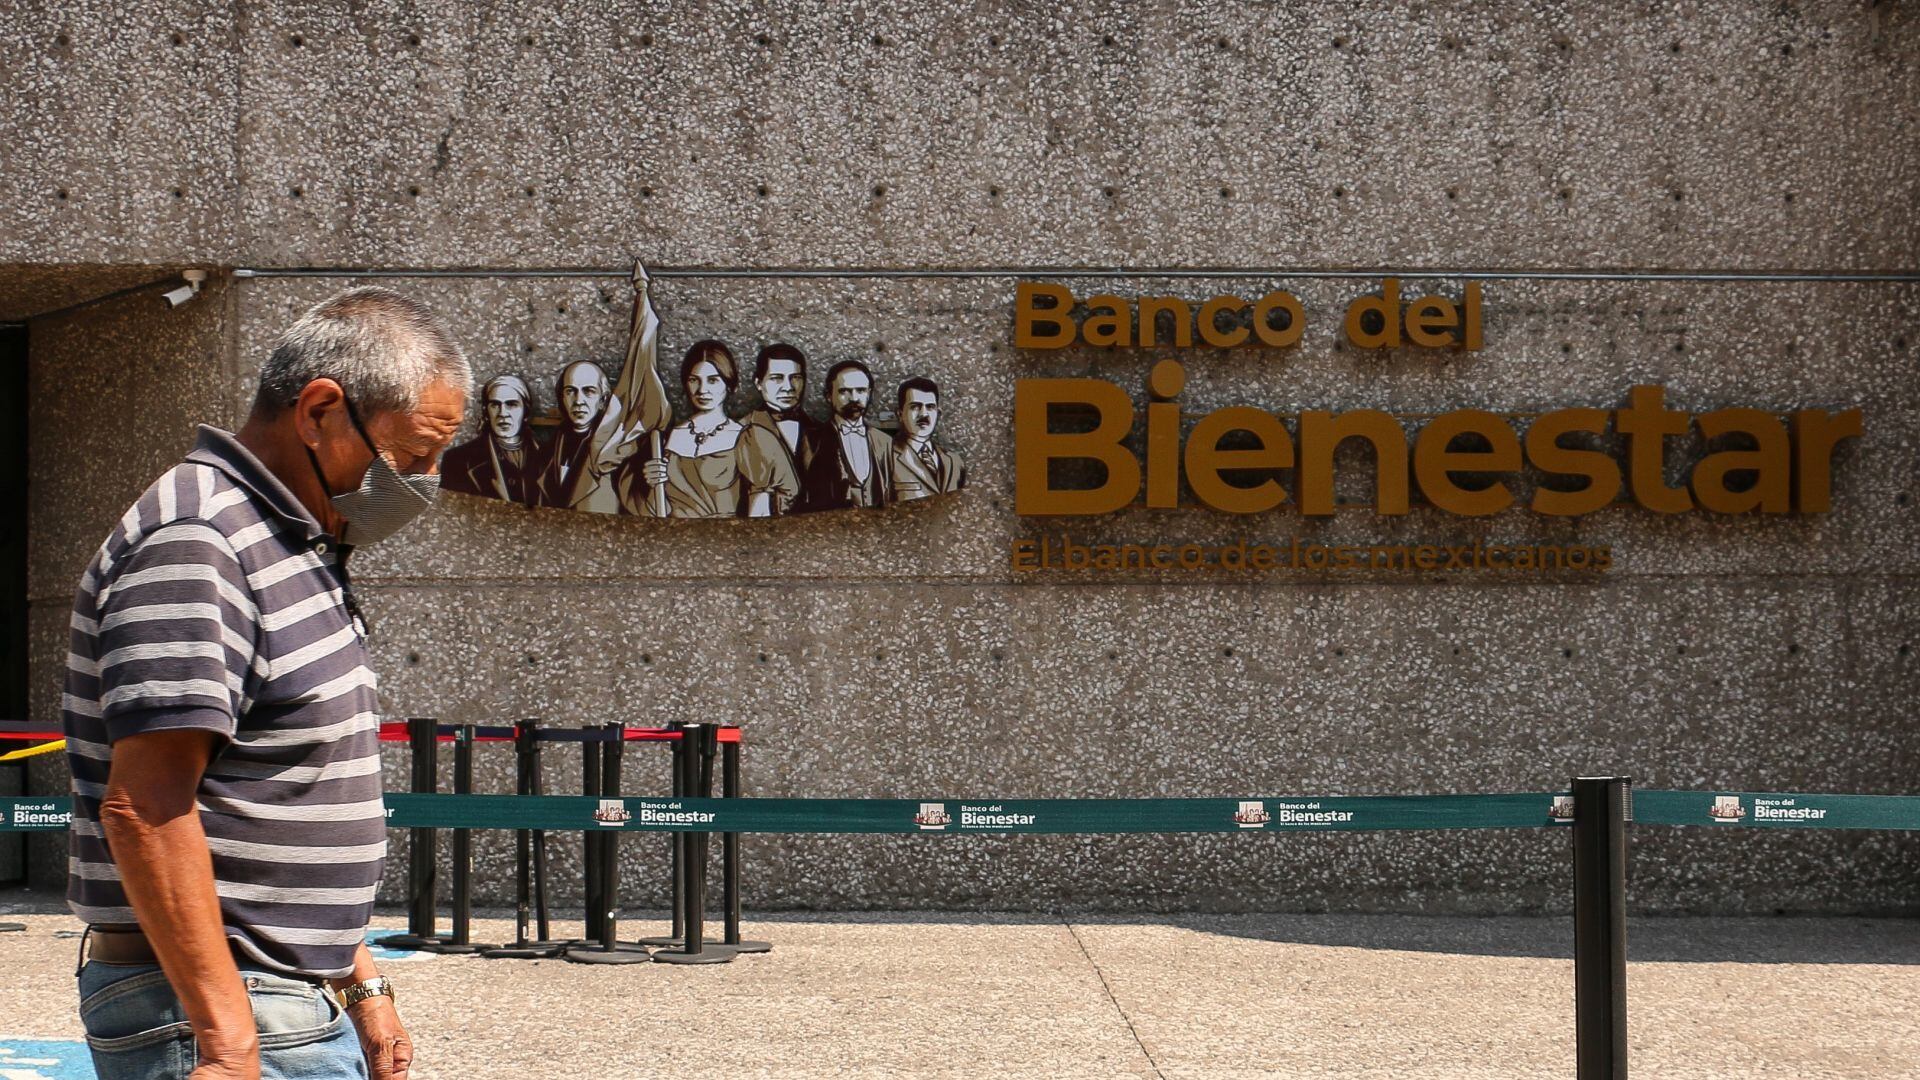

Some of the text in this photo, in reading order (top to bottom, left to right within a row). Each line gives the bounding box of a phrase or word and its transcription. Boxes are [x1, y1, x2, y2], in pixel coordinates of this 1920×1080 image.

[1015, 278, 1484, 351] Banco del
[1015, 359, 1864, 517] Bienestar
[1012, 536, 1614, 573] El banco de los mexicanos
[14, 803, 55, 811] Banco del
[641, 801, 682, 810] Banco del
[1280, 802, 1320, 810] Banco del
[1755, 798, 1795, 806] Banco del
[13, 811, 72, 823] Bienest
[640, 809, 716, 823] Bienestar
[961, 812, 1036, 825] Bienestar
[1280, 810, 1354, 822] Bienestar
[1754, 806, 1827, 819] Bienestar
